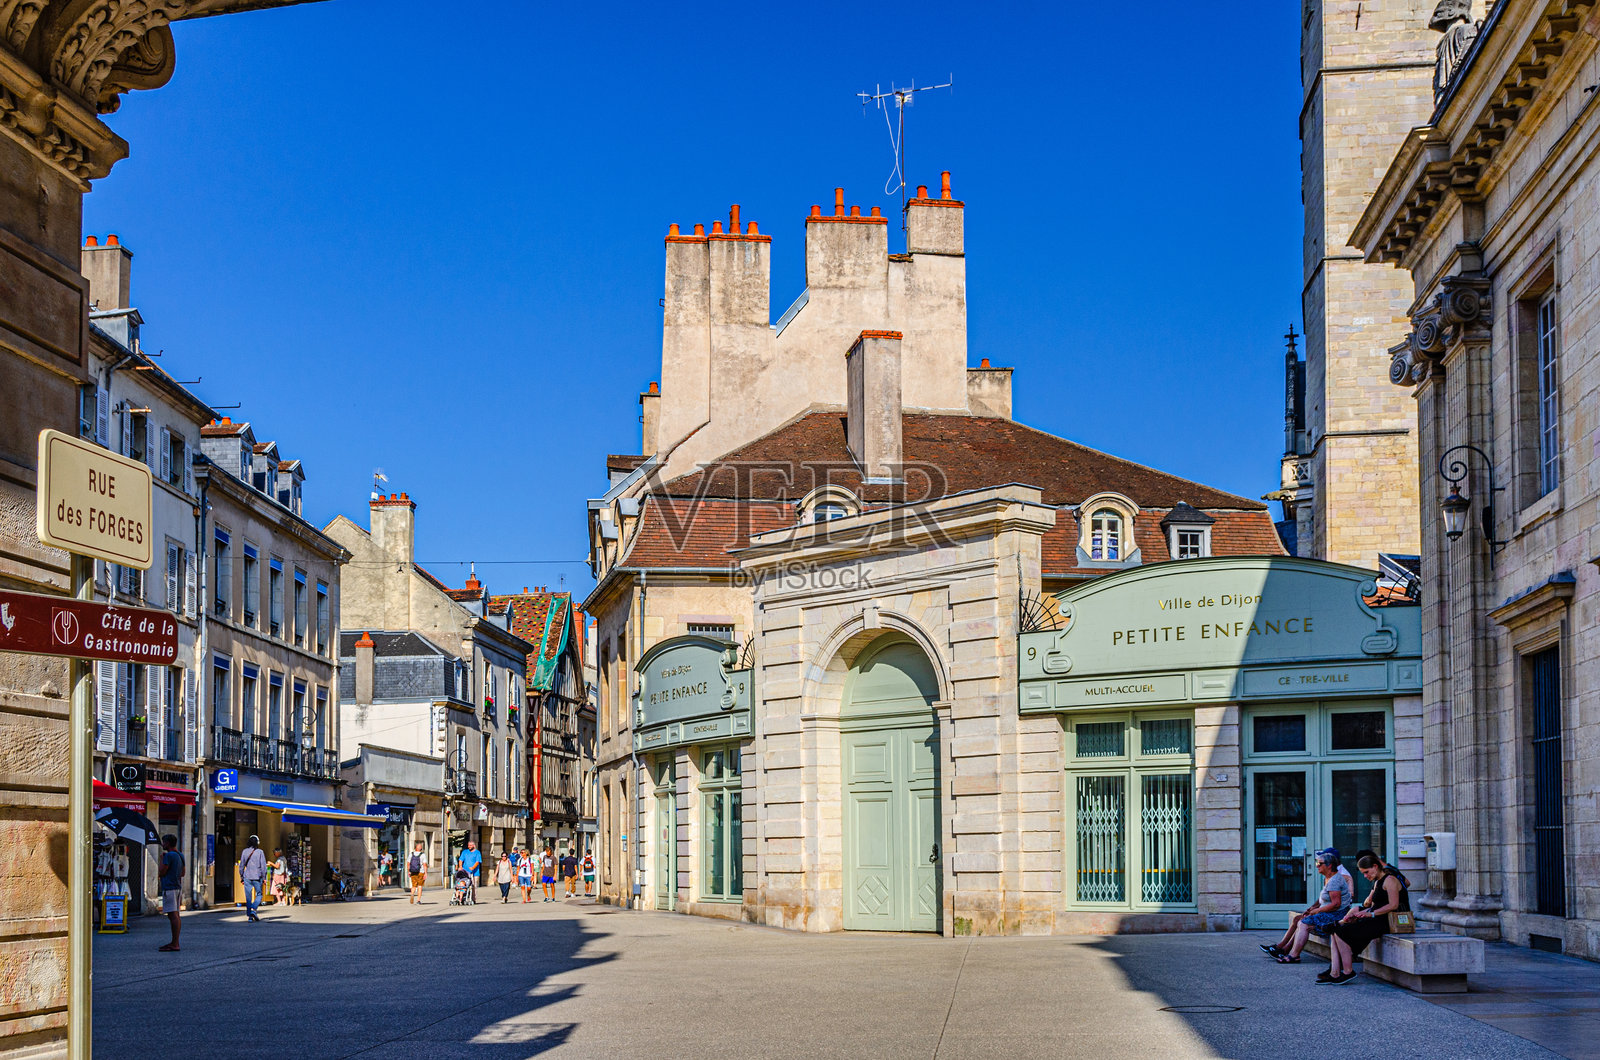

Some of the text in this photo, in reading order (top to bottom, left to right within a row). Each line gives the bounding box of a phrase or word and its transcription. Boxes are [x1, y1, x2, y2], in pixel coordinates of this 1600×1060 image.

[88, 468, 116, 499] RUE
[57, 499, 144, 545] des FORGES
[1158, 593, 1264, 611] Ville de Dijon
[138, 616, 155, 634] de
[161, 619, 174, 636] la
[1112, 616, 1315, 646] PETITE ENFANCE
[83, 632, 175, 658] Gastronomie
[1026, 646, 1038, 661] 9
[739, 683, 744, 694] 9
[1277, 673, 1350, 686] CETRE-VILLE
[672, 682, 707, 700] ENFANCE
[1084, 683, 1156, 697] MULTI-ACCUEIL
[217, 771, 230, 785] G
